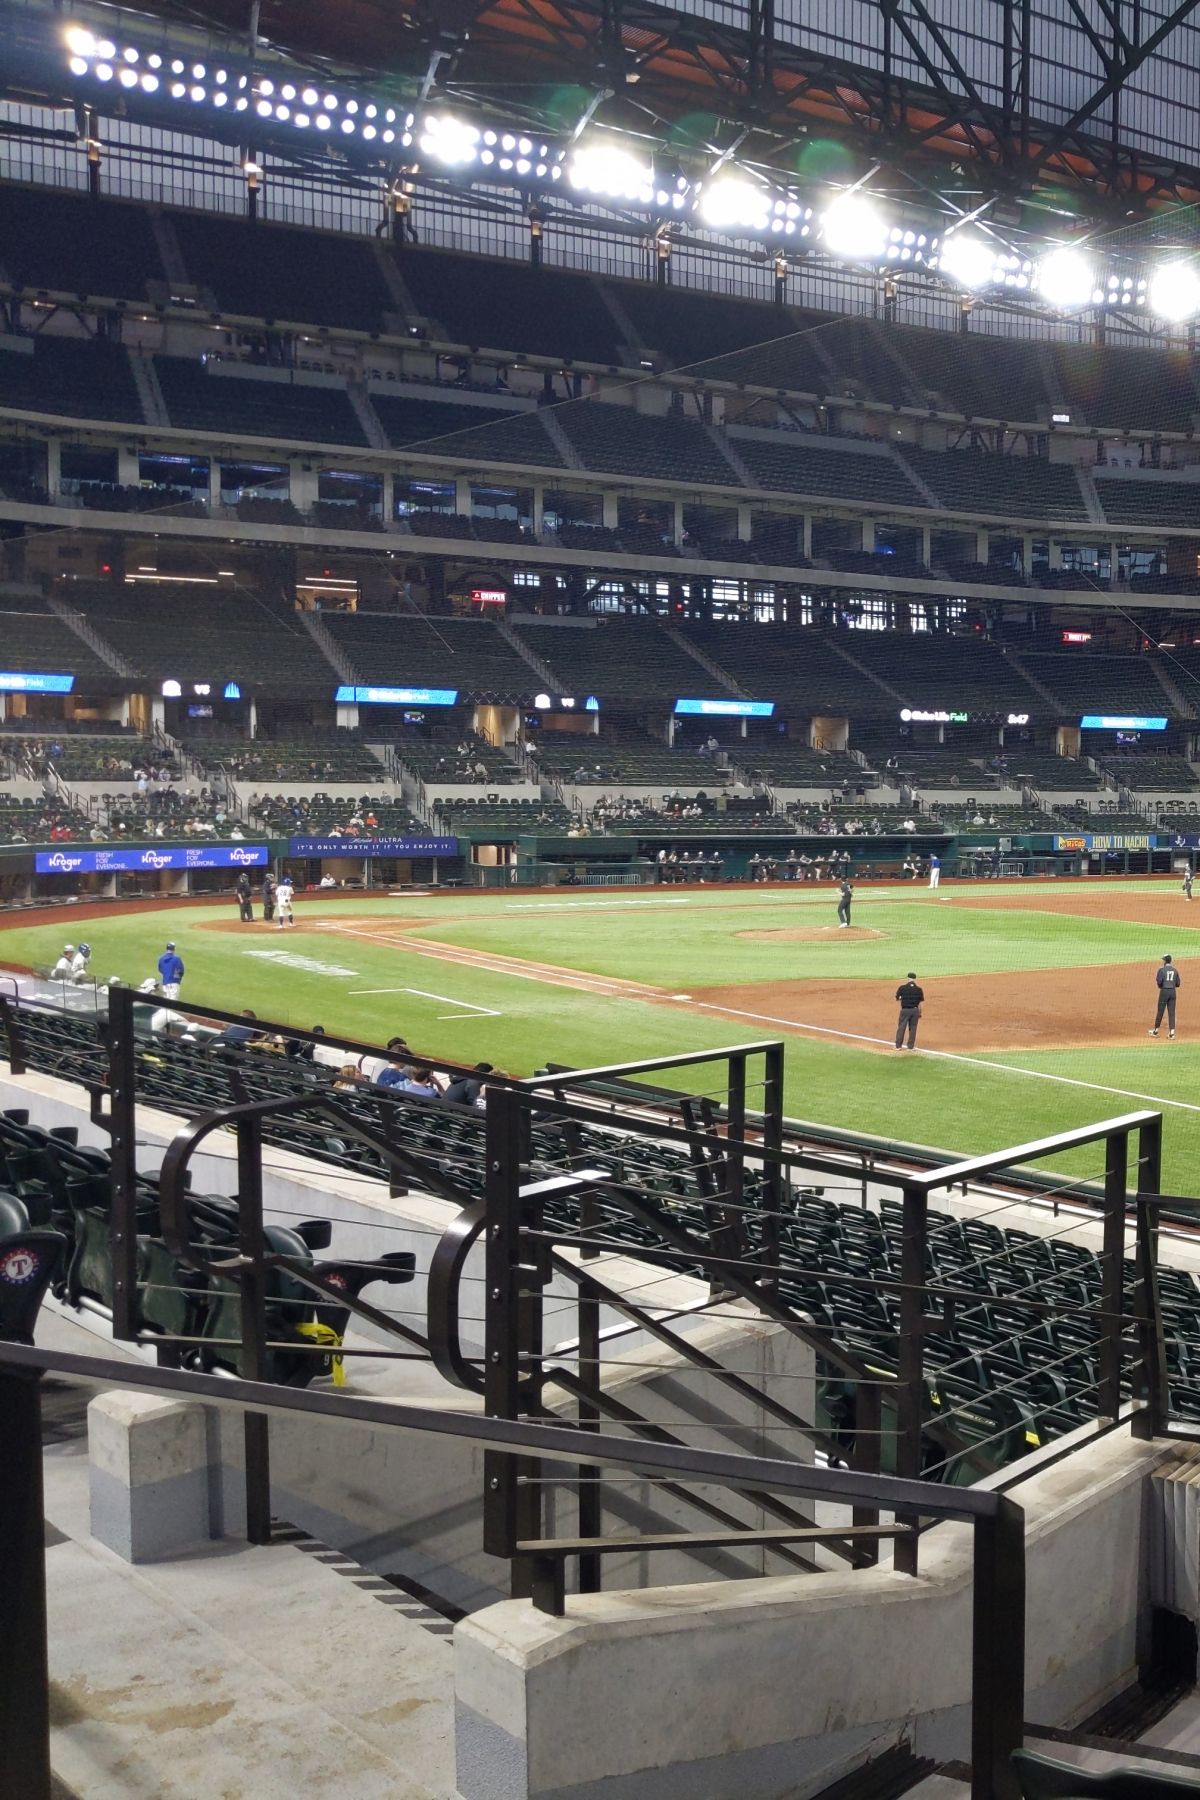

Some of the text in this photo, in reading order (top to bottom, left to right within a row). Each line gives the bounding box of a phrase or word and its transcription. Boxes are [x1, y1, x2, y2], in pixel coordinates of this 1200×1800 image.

[950, 712, 967, 721] Field
[1093, 836, 1111, 848] HOW
[1113, 836, 1123, 848] TO
[1125, 835, 1149, 848] NACHO
[49, 853, 82, 871] Kroger
[142, 850, 173, 869] Kroger
[230, 848, 259, 865] Kroger
[1166, 971, 1174, 981] 17
[12, 1259, 27, 1277] T
